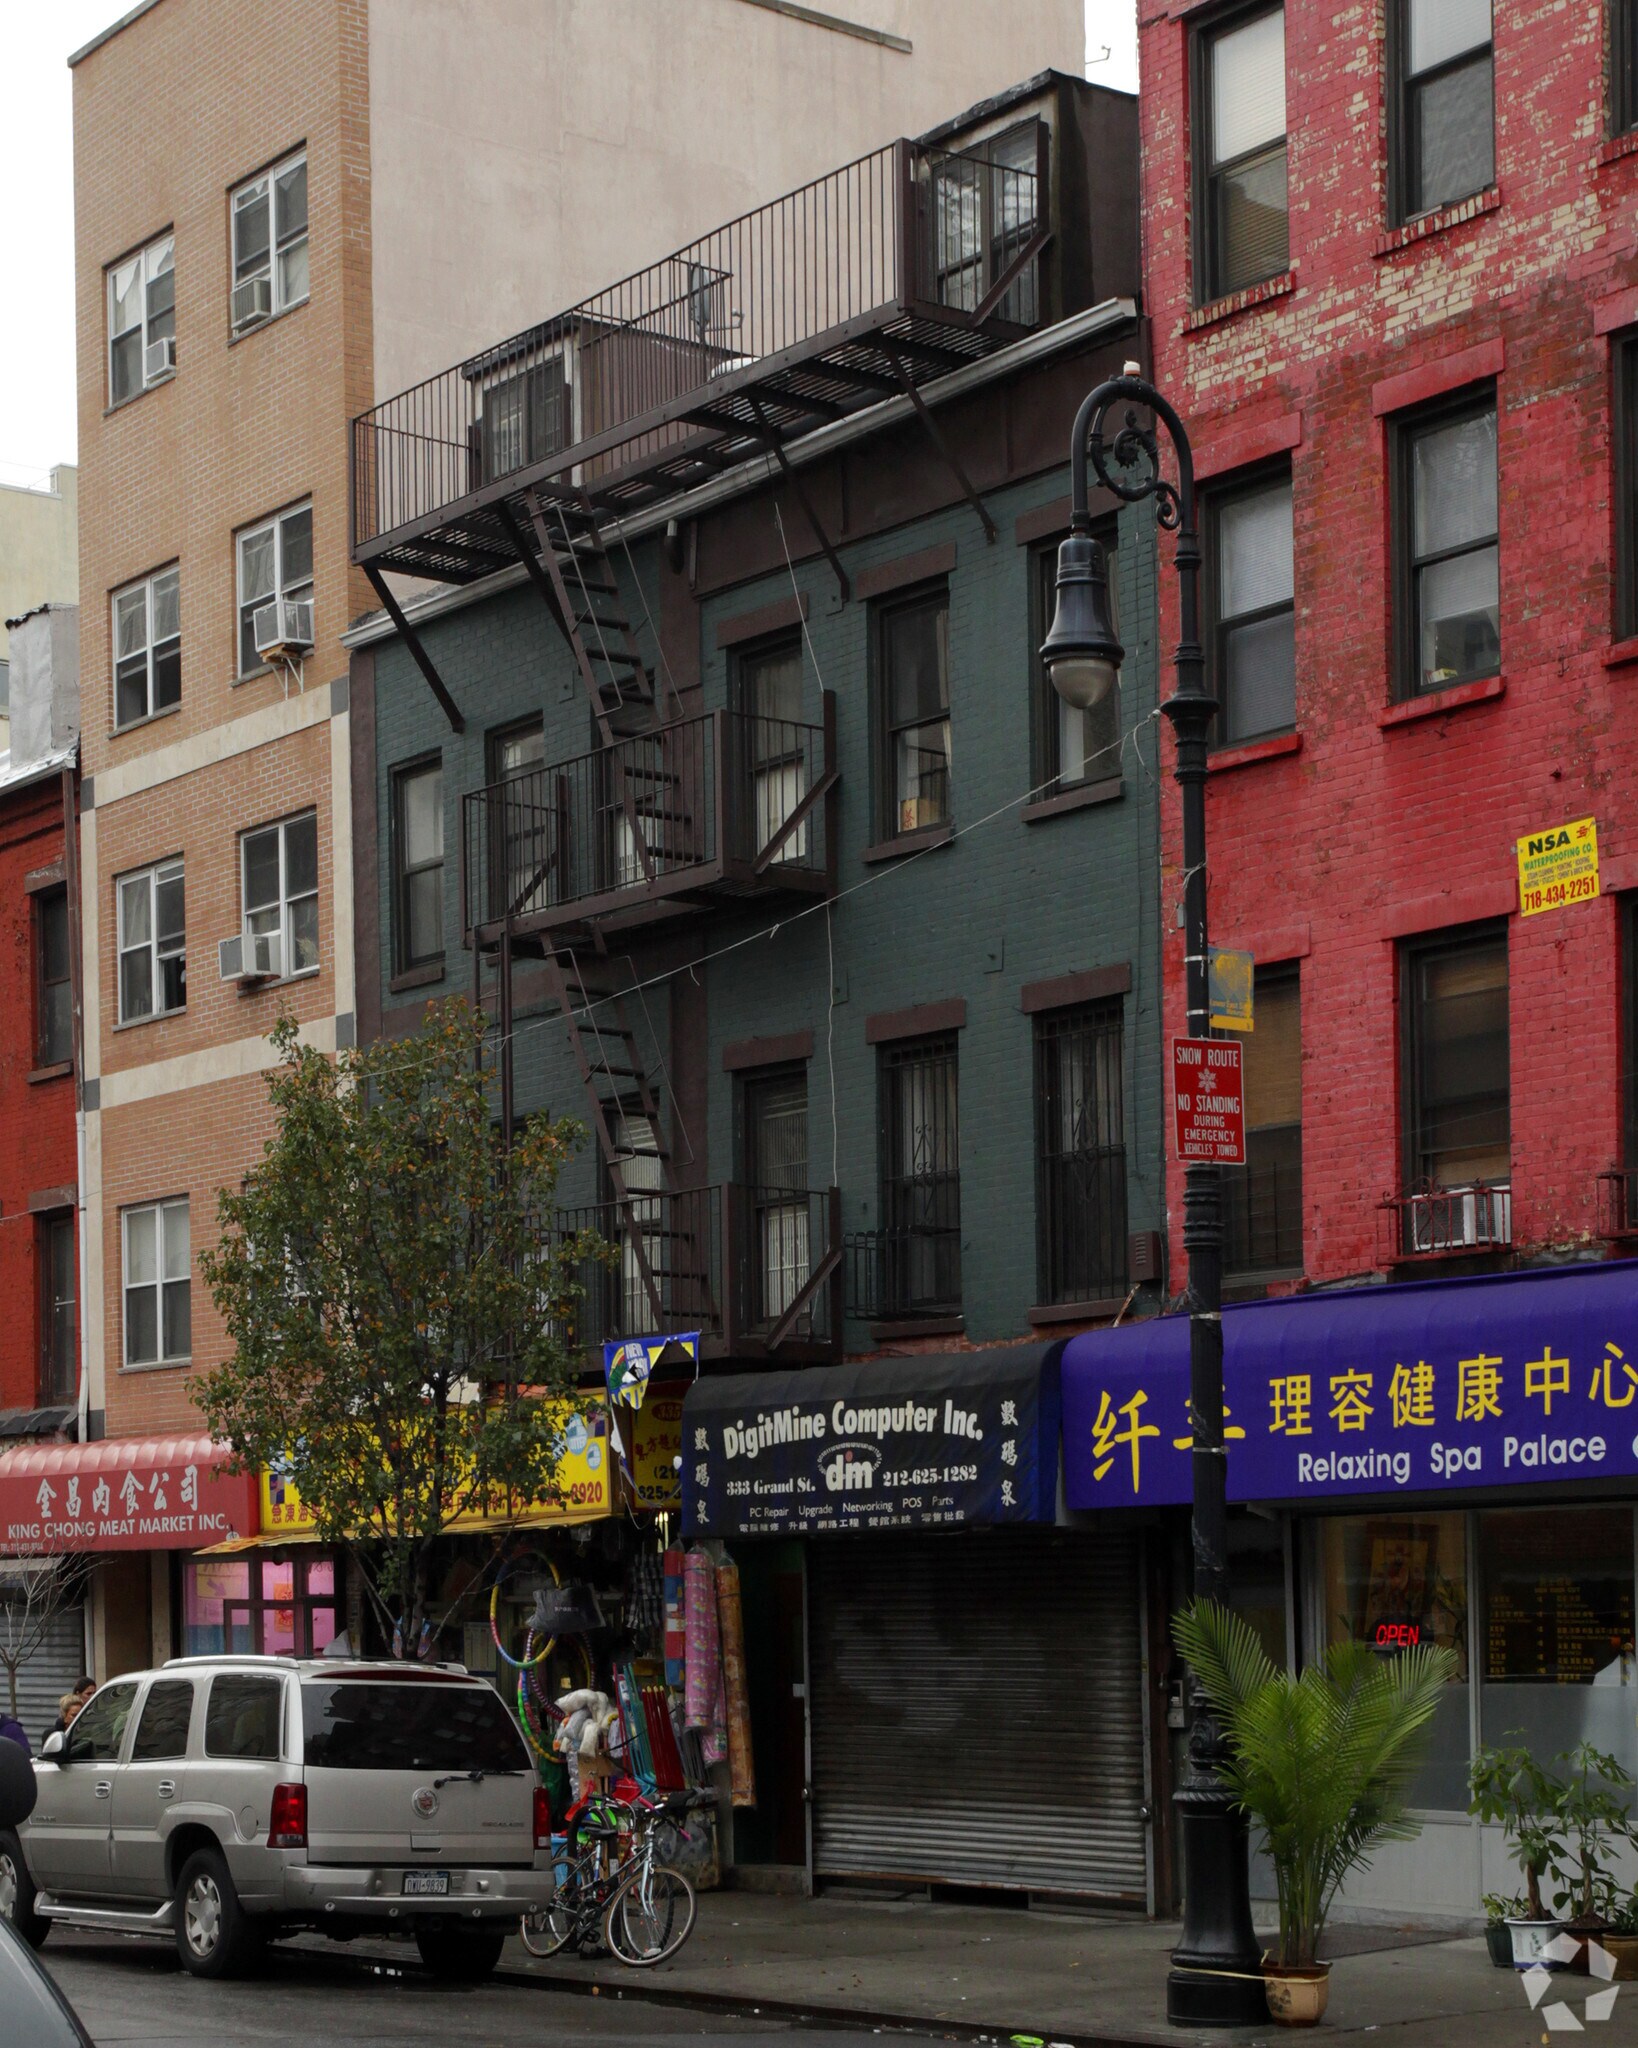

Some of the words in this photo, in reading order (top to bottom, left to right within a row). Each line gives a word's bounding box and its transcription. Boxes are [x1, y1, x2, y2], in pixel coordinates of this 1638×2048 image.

[1528, 831, 1570, 856] NSA
[1524, 846, 1580, 871] WATERPROOFING
[1524, 875, 1595, 911] 718-434-2251
[1177, 1047, 1202, 1064] SNOW
[1208, 1049, 1239, 1067] ROUTE
[1178, 1094, 1190, 1111] NO
[1196, 1095, 1240, 1114] STANDING
[1194, 1115, 1225, 1127] DURING
[1184, 1128, 1235, 1142] EMERGENCY
[1184, 1143, 1213, 1156] VEHICLES
[1216, 1145, 1238, 1157] TOWED
[723, 1405, 826, 1460] DigitMine
[832, 1400, 938, 1440] Computer
[944, 1400, 983, 1441] Inc.
[1298, 1448, 1411, 1484] Relaxing
[1430, 1442, 1482, 1479] Spa
[1503, 1433, 1607, 1468] Palace
[726, 1481, 750, 1496] 333
[753, 1478, 794, 1495] Grand
[797, 1476, 816, 1492] St.
[883, 1464, 977, 1487] 212-625-1282
[750, 1507, 761, 1517] PC
[764, 1507, 789, 1519] Repair
[798, 1503, 833, 1517] Upgrade
[842, 1501, 893, 1513] Networking
[902, 1497, 922, 1508] POS
[932, 1496, 954, 1506] Parts
[8, 1523, 40, 1539] KING
[44, 1521, 96, 1538] CHONG
[99, 1518, 135, 1536] MEAT
[139, 1515, 194, 1534] MARKET
[198, 1513, 229, 1530] INC.
[1376, 1624, 1419, 1646] OPEN
